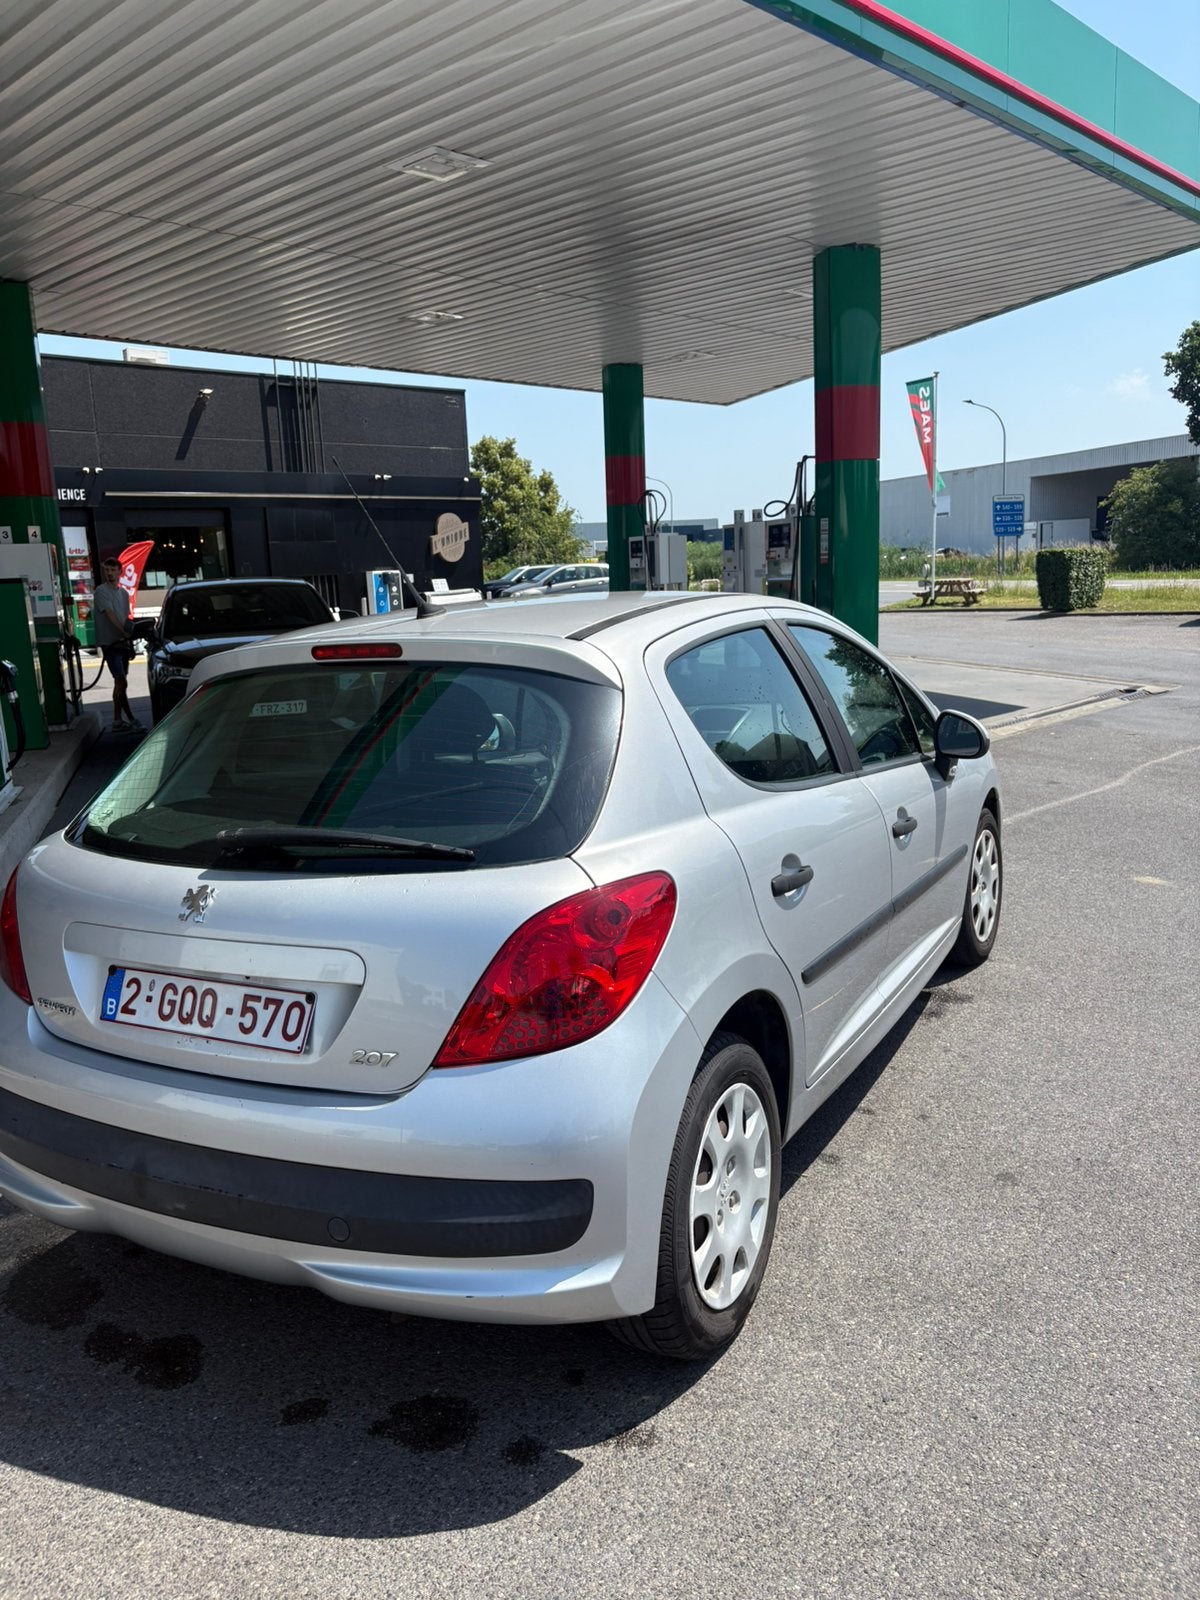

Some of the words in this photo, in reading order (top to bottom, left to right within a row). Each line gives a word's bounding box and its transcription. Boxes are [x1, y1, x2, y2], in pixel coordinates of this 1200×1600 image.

[2, 530, 9, 539] 3
[31, 530, 38, 538] 4
[106, 998, 117, 1015] B
[350, 1049, 399, 1067] 207
